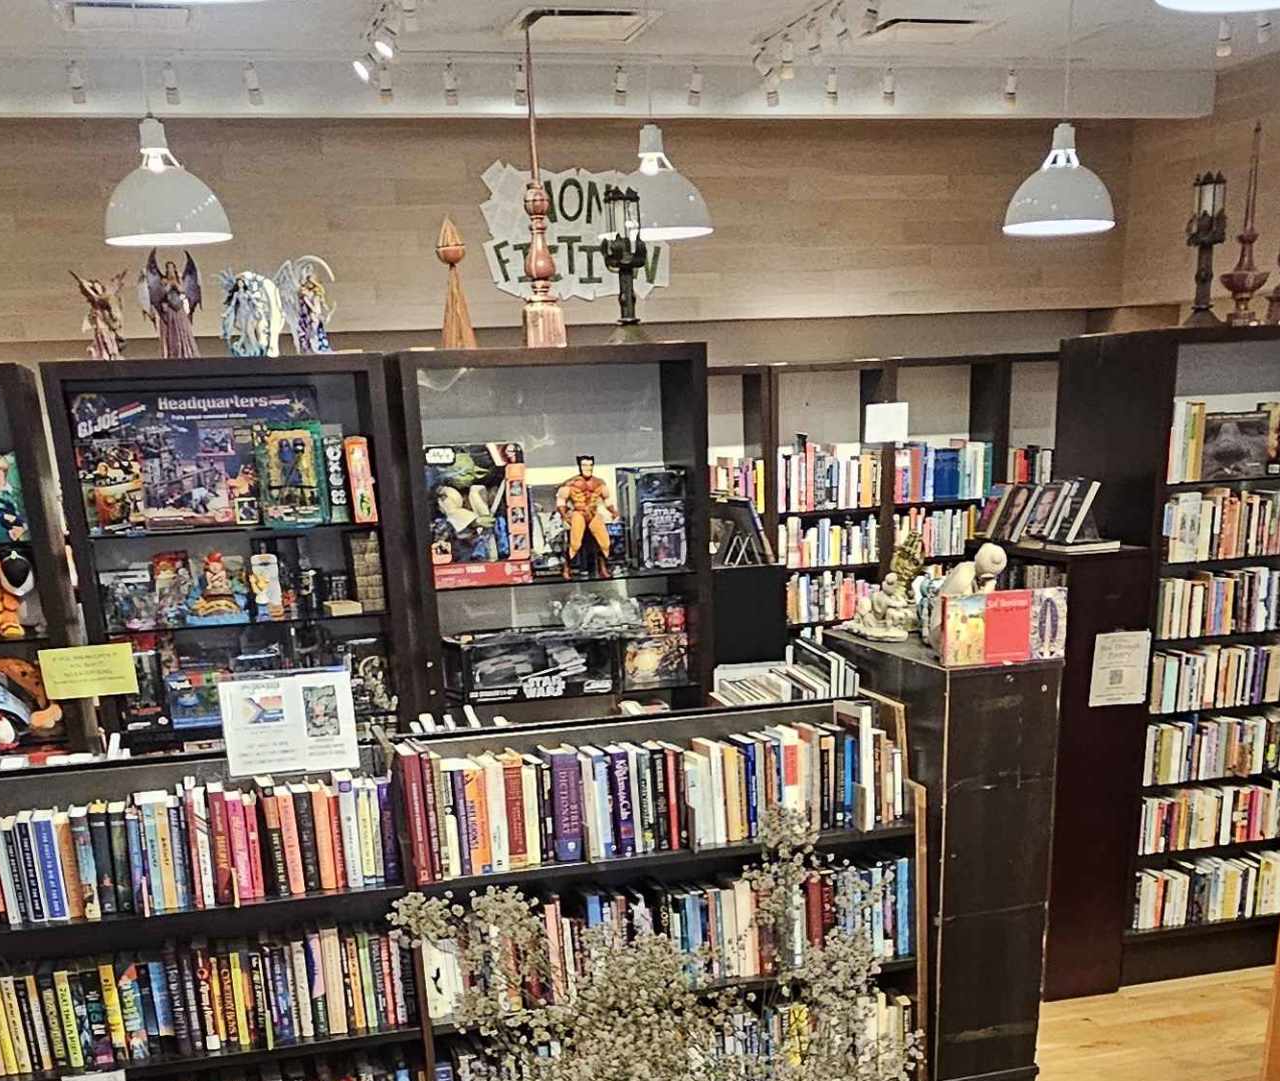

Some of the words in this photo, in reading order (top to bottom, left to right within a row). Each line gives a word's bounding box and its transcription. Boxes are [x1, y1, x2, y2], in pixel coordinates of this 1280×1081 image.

[493, 235, 661, 284] FITIN
[158, 394, 268, 412] Headquarters
[523, 676, 565, 688] STAR
[525, 686, 565, 699] WARS
[558, 771, 570, 835] DICTIONARY
[568, 803, 578, 833] BIBLE
